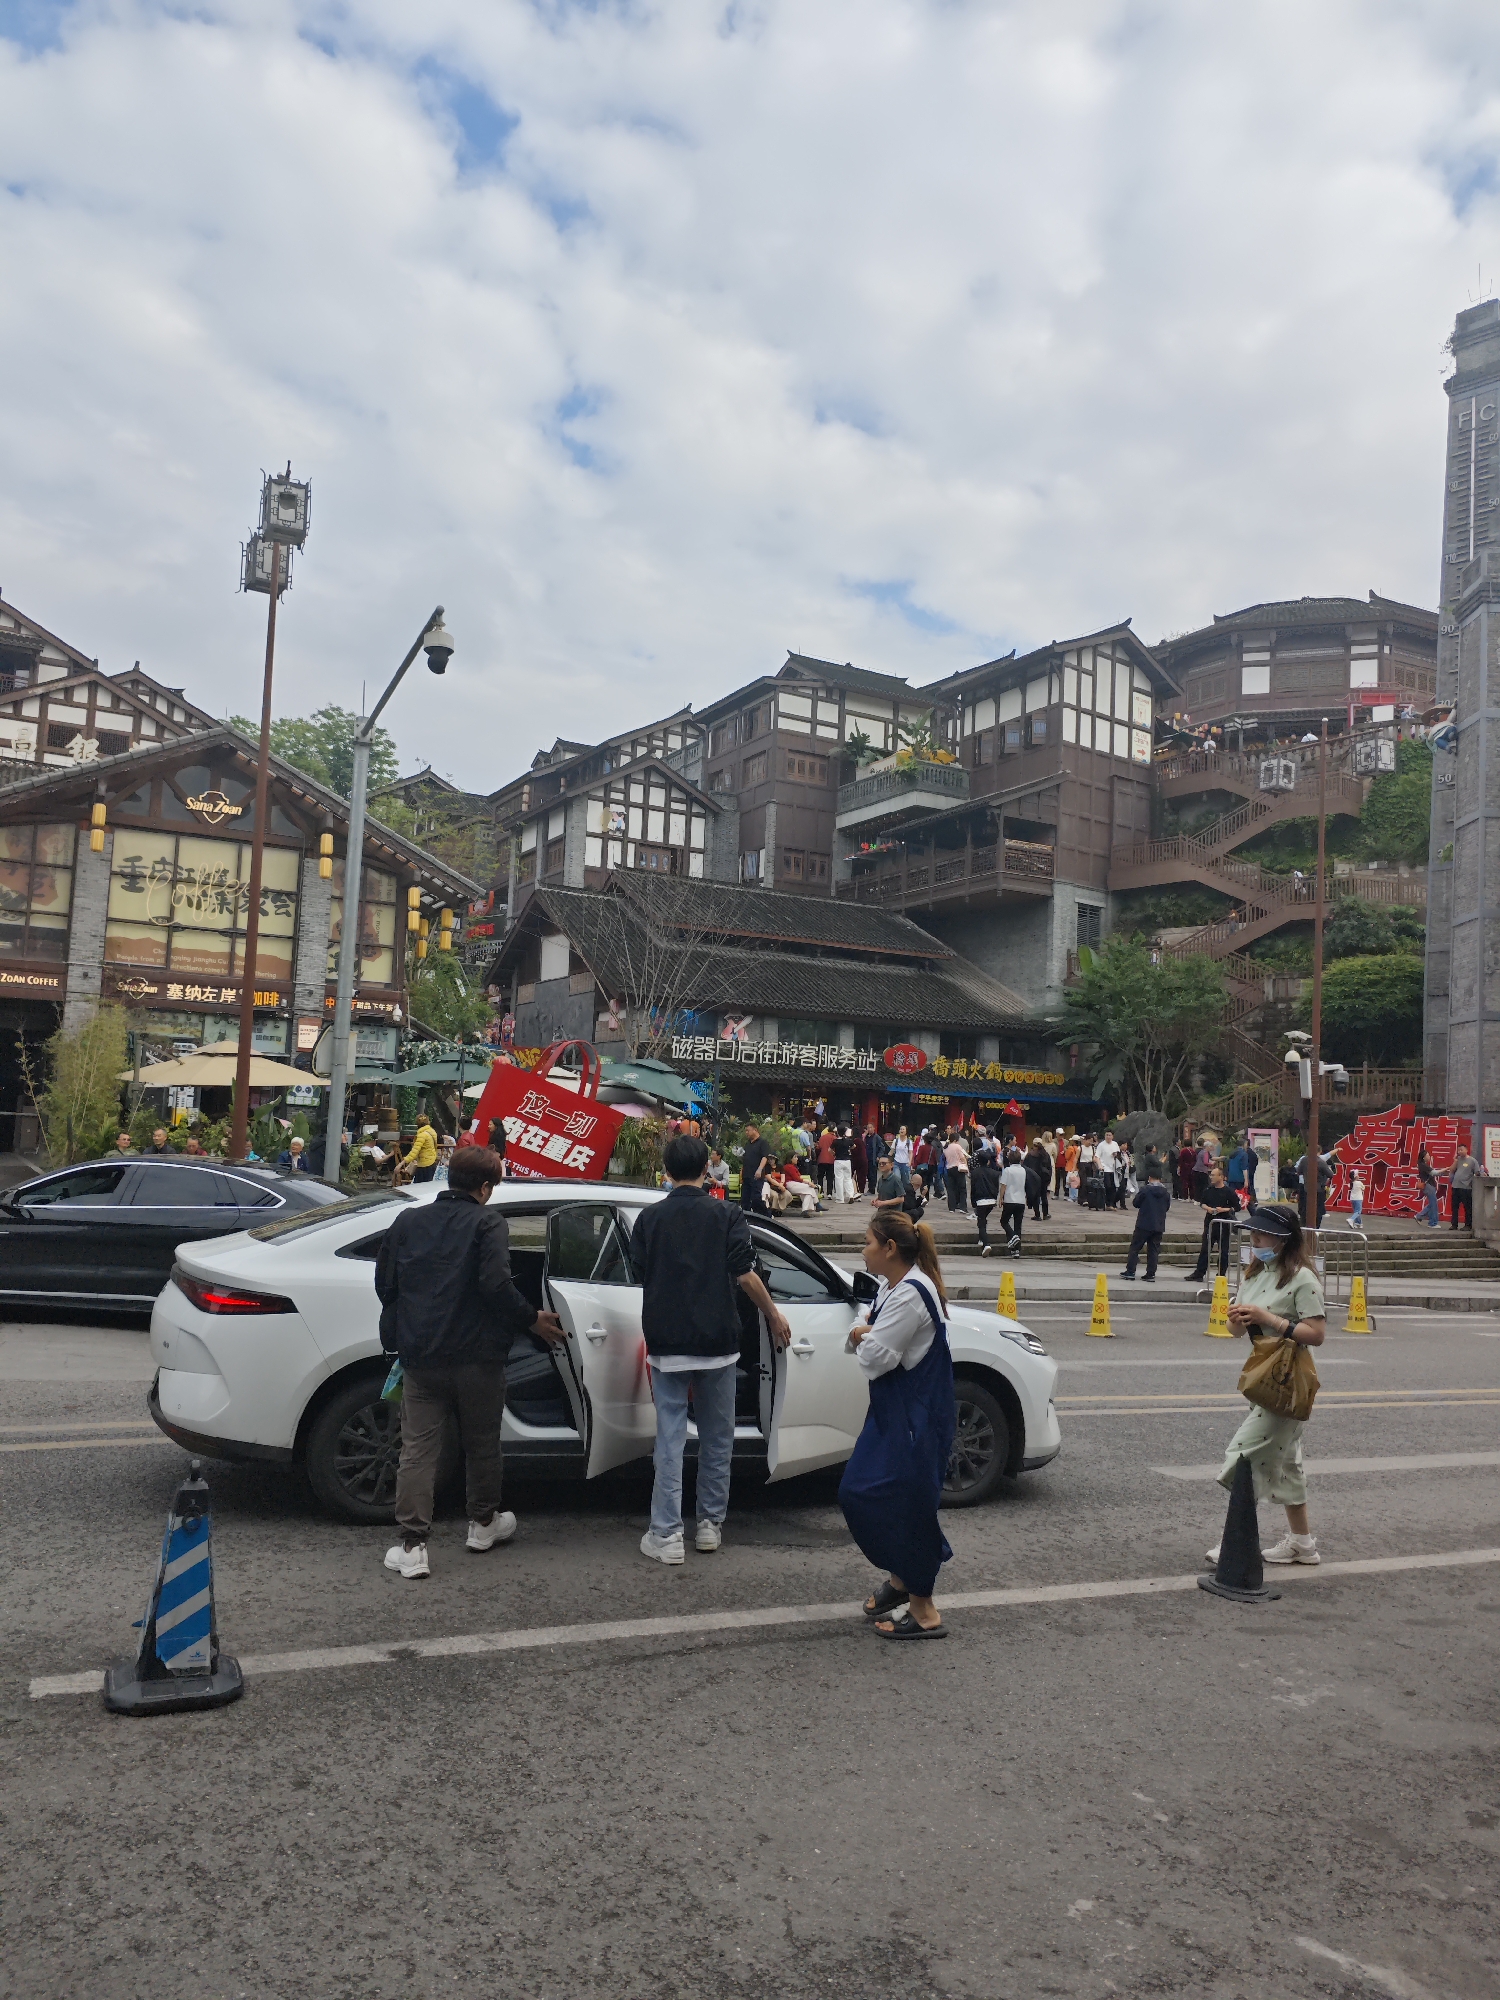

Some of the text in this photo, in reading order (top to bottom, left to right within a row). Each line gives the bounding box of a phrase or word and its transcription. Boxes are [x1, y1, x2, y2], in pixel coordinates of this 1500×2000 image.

[1458, 409, 1472, 429] F
[1480, 403, 1496, 421] C
[1488, 497, 1500, 507] 50
[1440, 624, 1455, 635] 90
[1437, 773, 1452, 784] 50
[185, 796, 243, 816] Sana Zoan
[671, 1034, 878, 1072] 磁器口后街游客服务站
[515, 1089, 599, 1139] 这一刻
[501, 1115, 596, 1172] 我在重庆
[1334, 1103, 1459, 1168] 爱情
[512, 1161, 530, 1175] THIS
